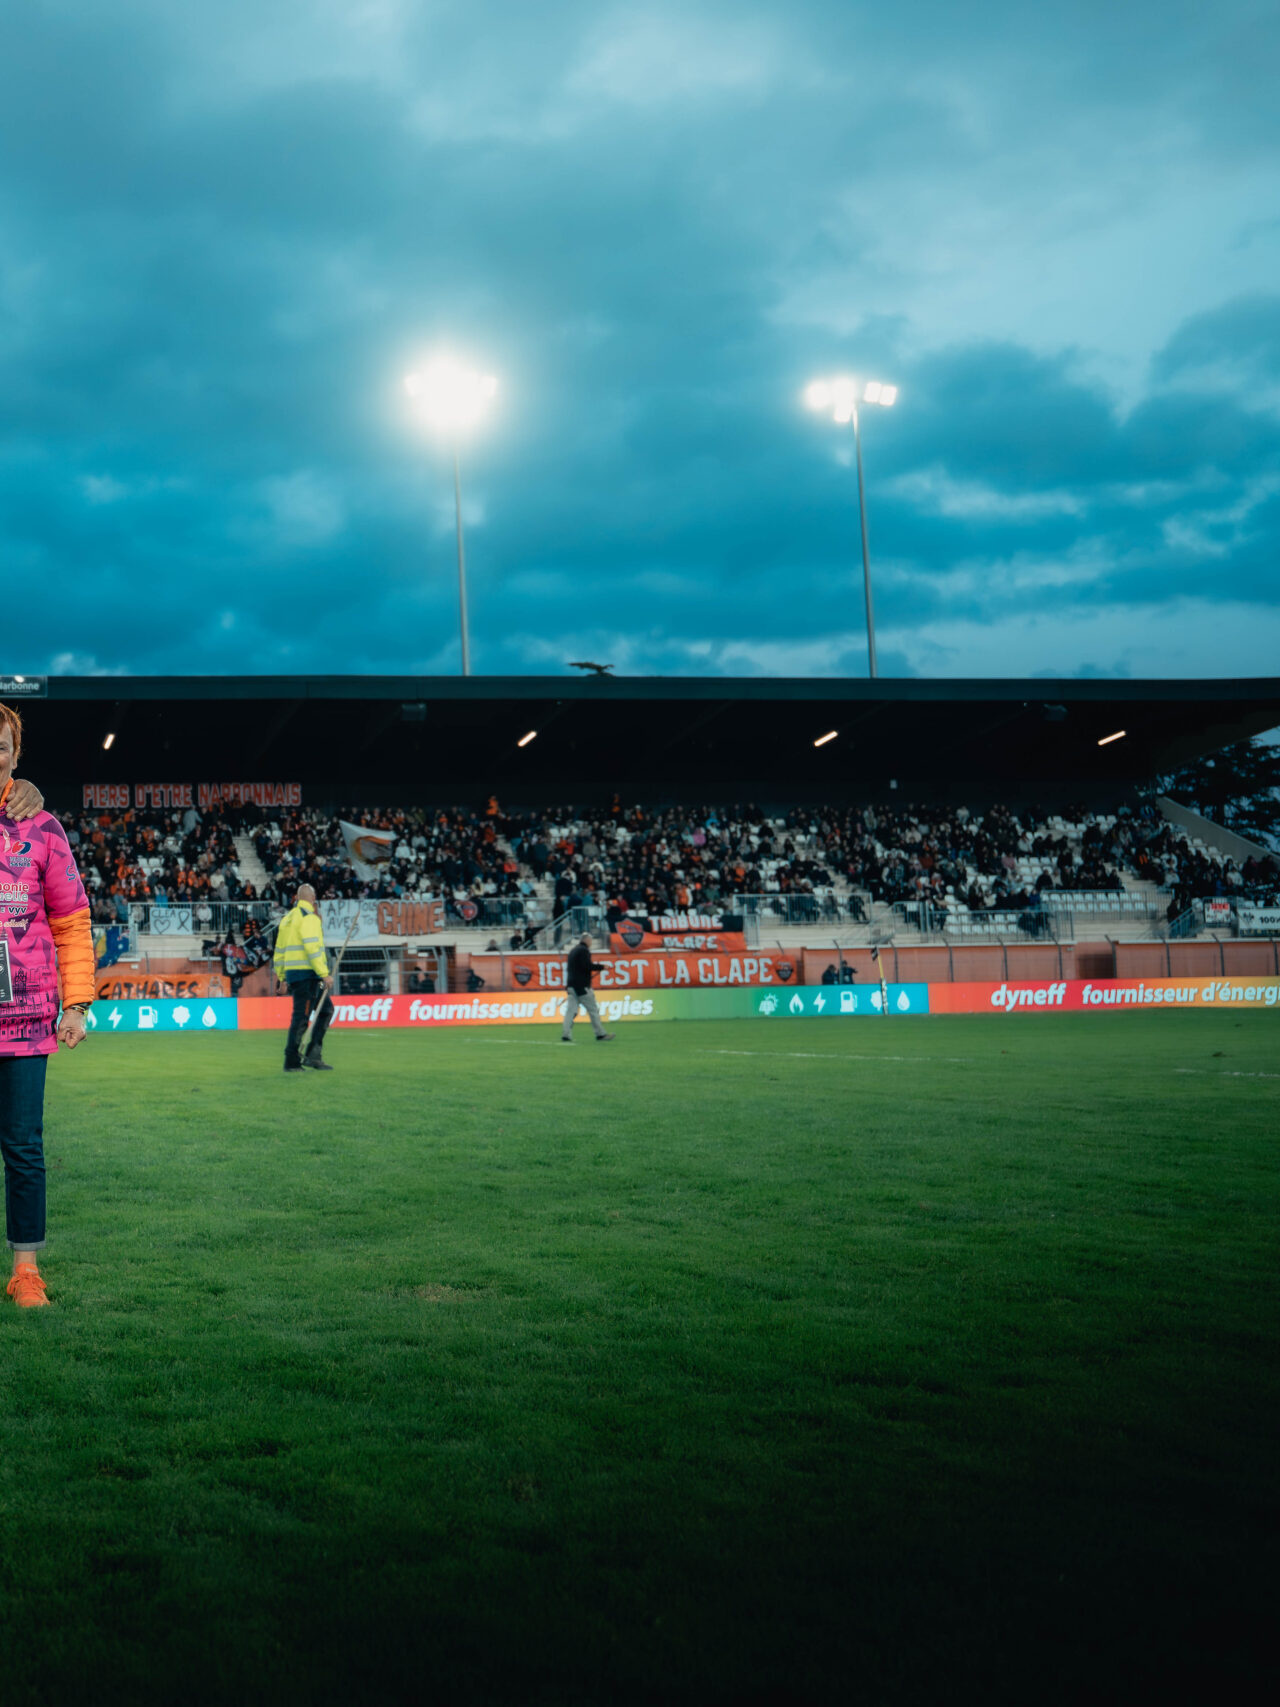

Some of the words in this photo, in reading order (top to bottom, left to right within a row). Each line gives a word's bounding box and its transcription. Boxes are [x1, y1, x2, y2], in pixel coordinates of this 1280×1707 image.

[83, 784, 129, 808] FIERS
[198, 783, 301, 807] NARBONNAIS
[8, 906, 27, 916] vyv
[378, 901, 443, 936] CHINE
[593, 959, 649, 986] EST
[658, 958, 691, 985] LA
[698, 957, 773, 985] CLAPE
[309, 998, 394, 1026] yneff
[409, 1000, 538, 1020] fournisseur
[540, 995, 653, 1021] d'érgies
[991, 983, 1067, 1011] dyneff
[1082, 984, 1199, 1004] fournisseur
[1201, 982, 1280, 1005] d'énerg
